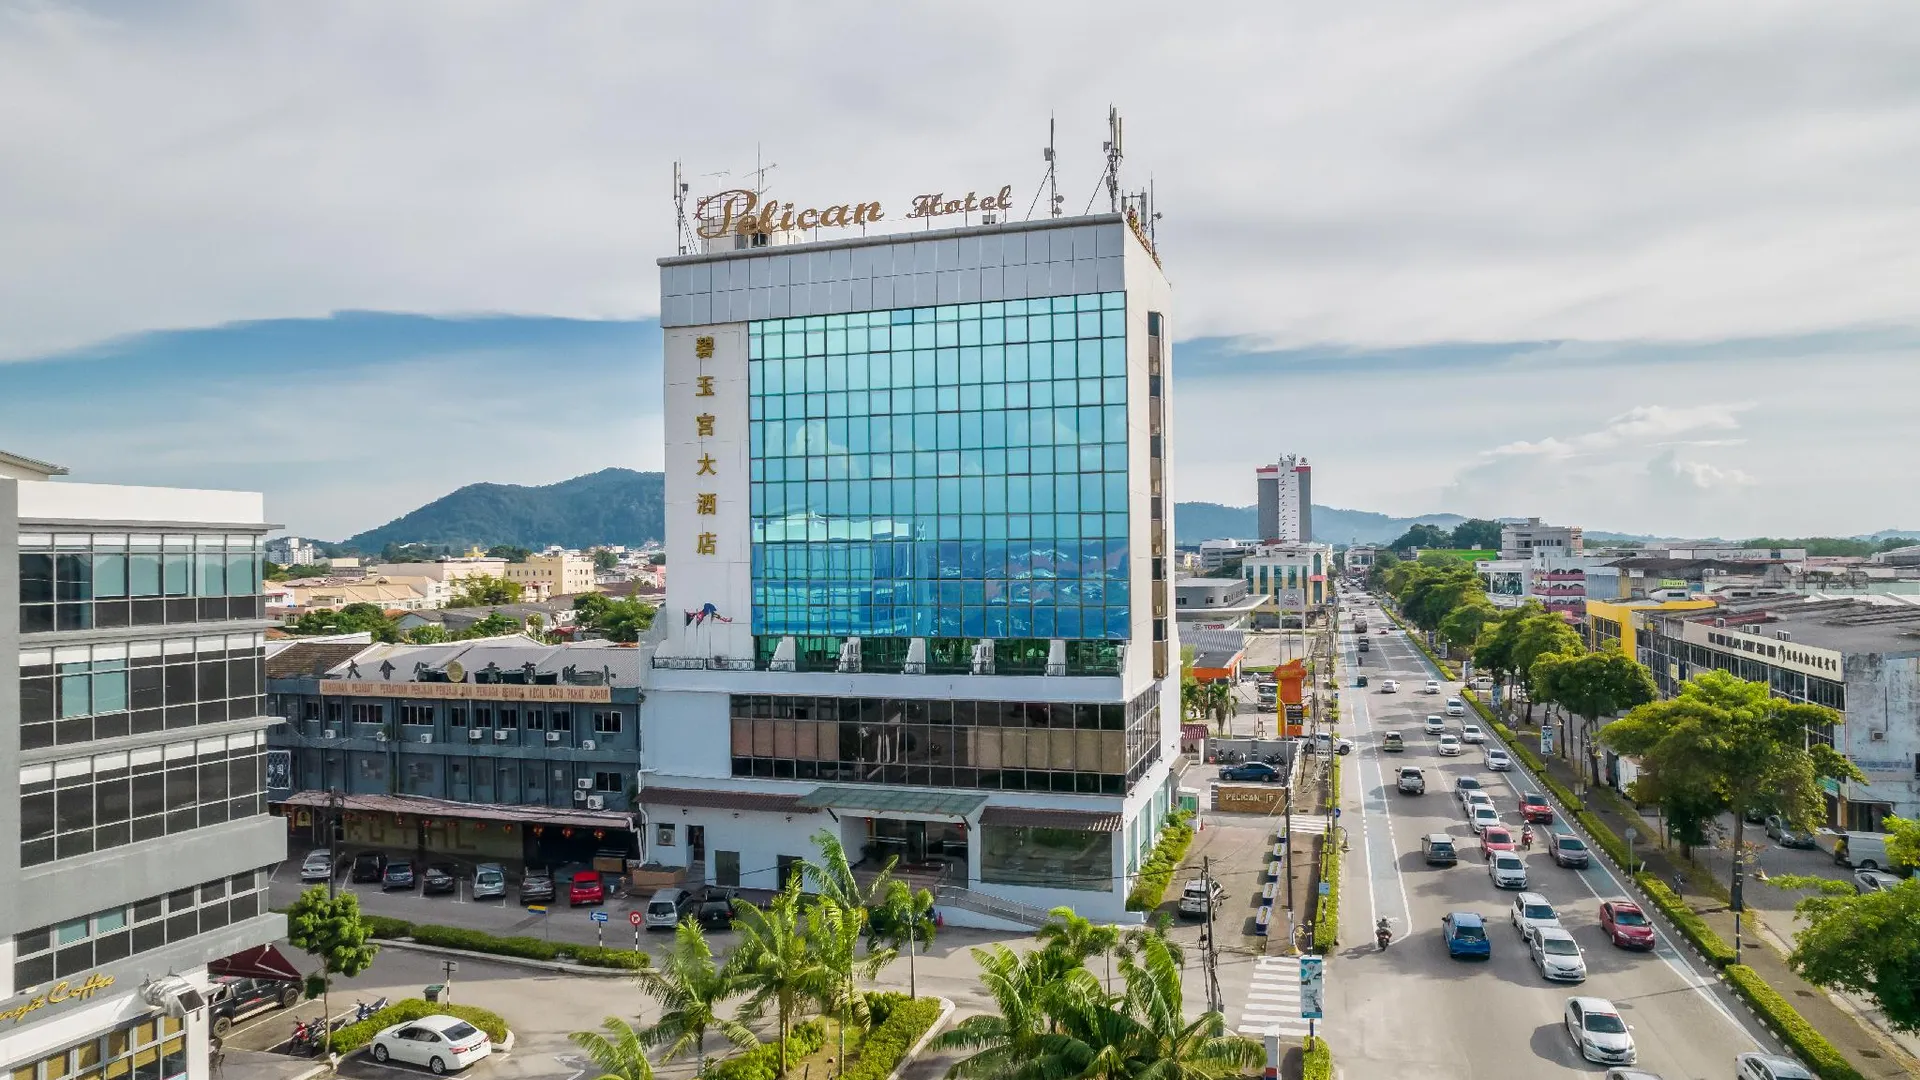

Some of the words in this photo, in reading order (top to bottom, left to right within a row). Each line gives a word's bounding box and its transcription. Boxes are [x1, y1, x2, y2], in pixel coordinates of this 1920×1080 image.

[694, 189, 885, 240] Pelican
[905, 184, 1013, 219] Hotel
[1225, 792, 1261, 803] PELICAN
[47, 973, 116, 1004] Coffee
